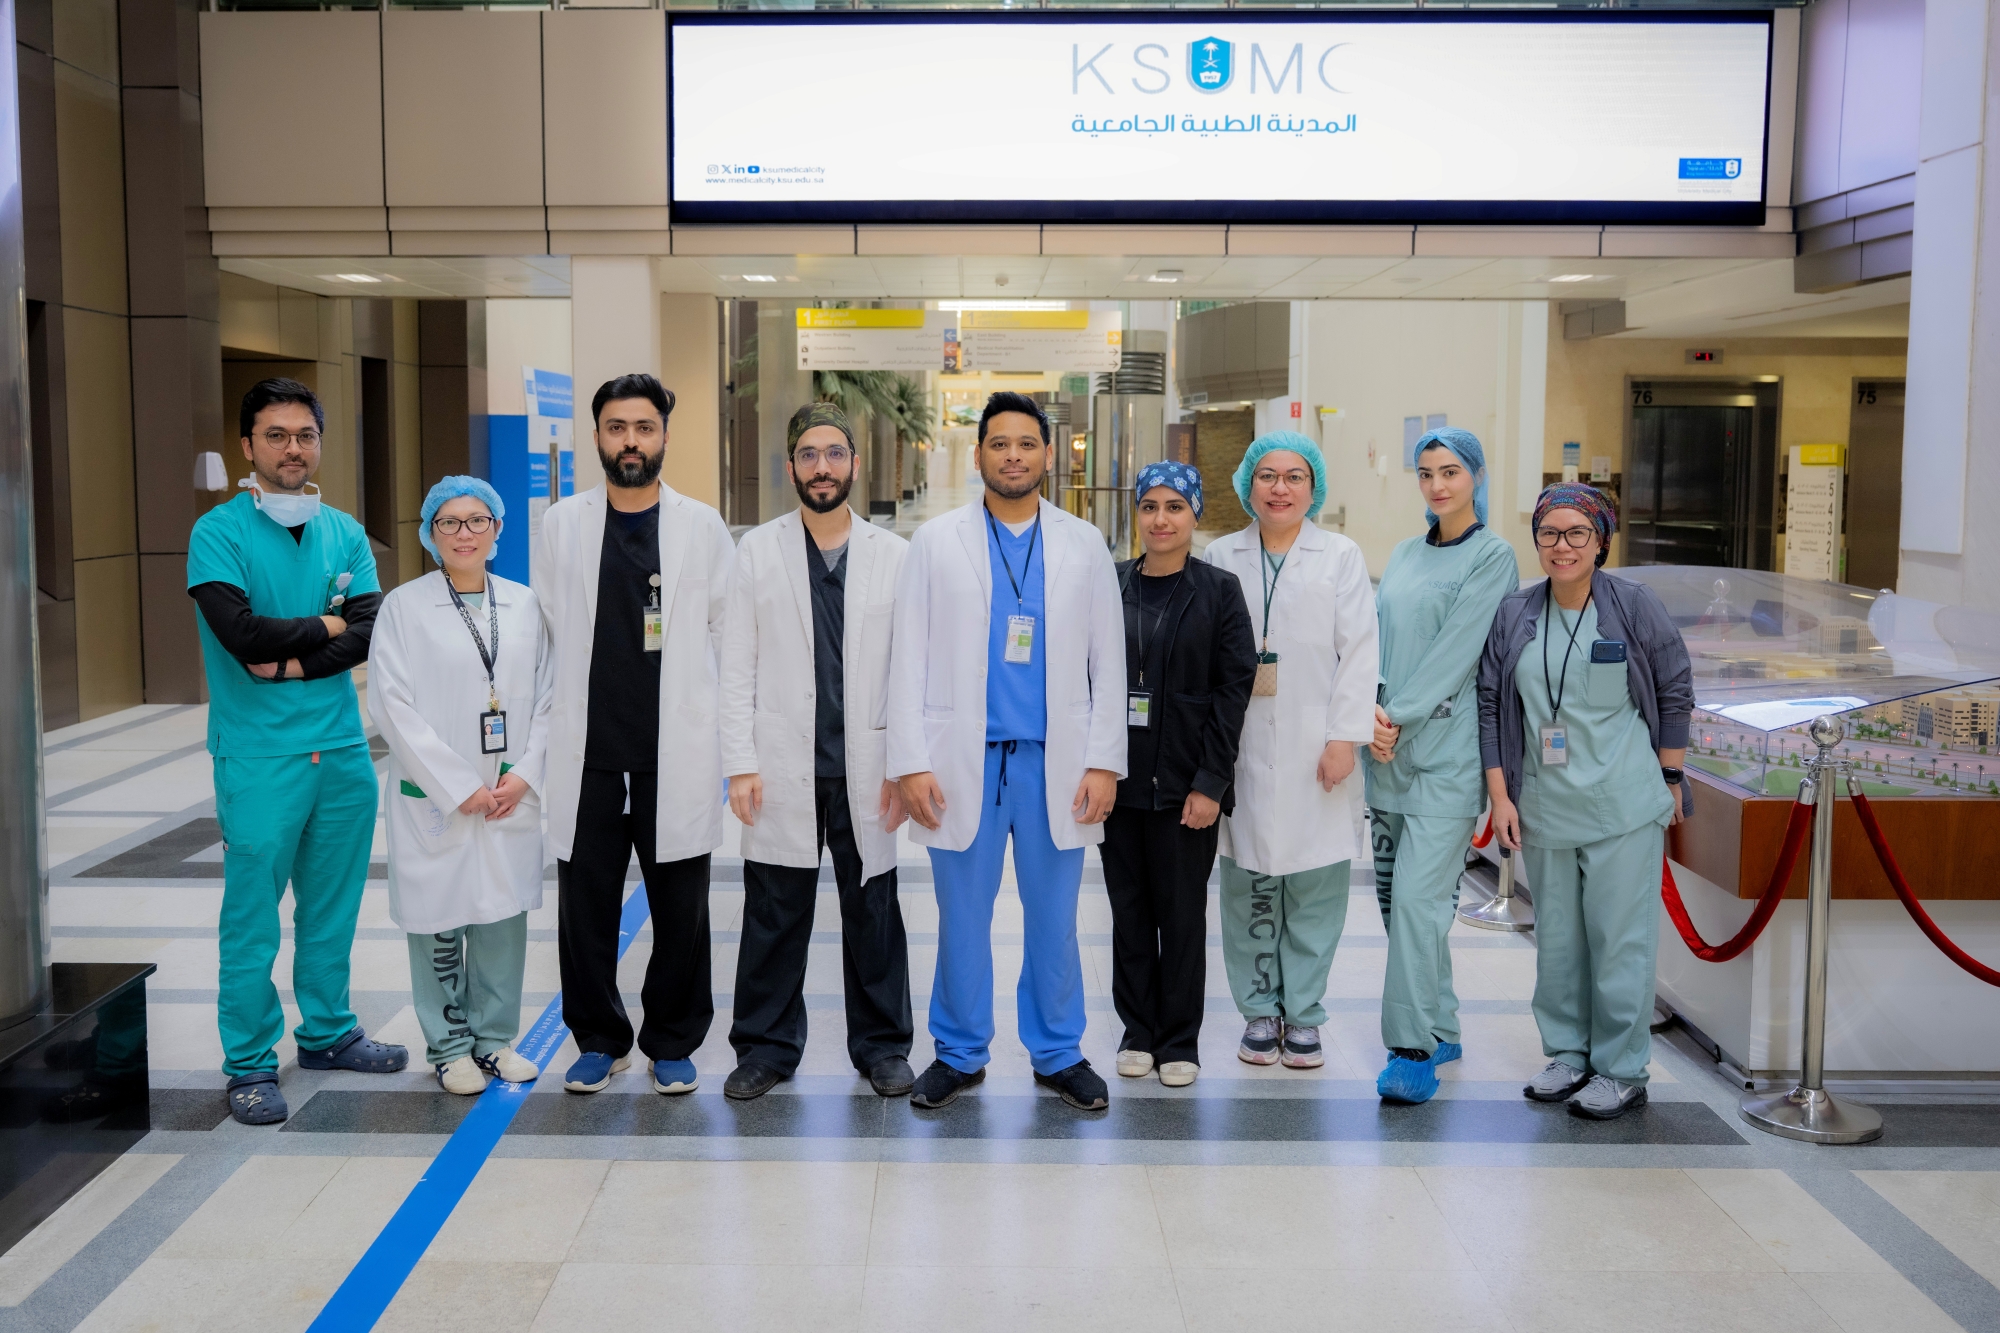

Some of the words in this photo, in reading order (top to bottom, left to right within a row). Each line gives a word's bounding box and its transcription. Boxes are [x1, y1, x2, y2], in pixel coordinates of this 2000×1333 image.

[1072, 41, 1355, 95] KSUMC
[1071, 113, 1175, 138] الجامعية
[1181, 113, 1261, 137] الطبية
[1267, 113, 1357, 137] المدينة
[763, 166, 825, 175] ksumedicalcity
[705, 176, 824, 185] www.medicalcity.ksu.edu.sa
[803, 310, 811, 325] 1
[967, 311, 974, 325] 1
[1633, 390, 1653, 404] 76
[1857, 391, 1877, 405] 75
[1828, 482, 1834, 497] 5
[1827, 502, 1833, 516] 4
[1827, 521, 1833, 536] 3
[1826, 540, 1832, 555] 2
[1826, 559, 1830, 574] 1
